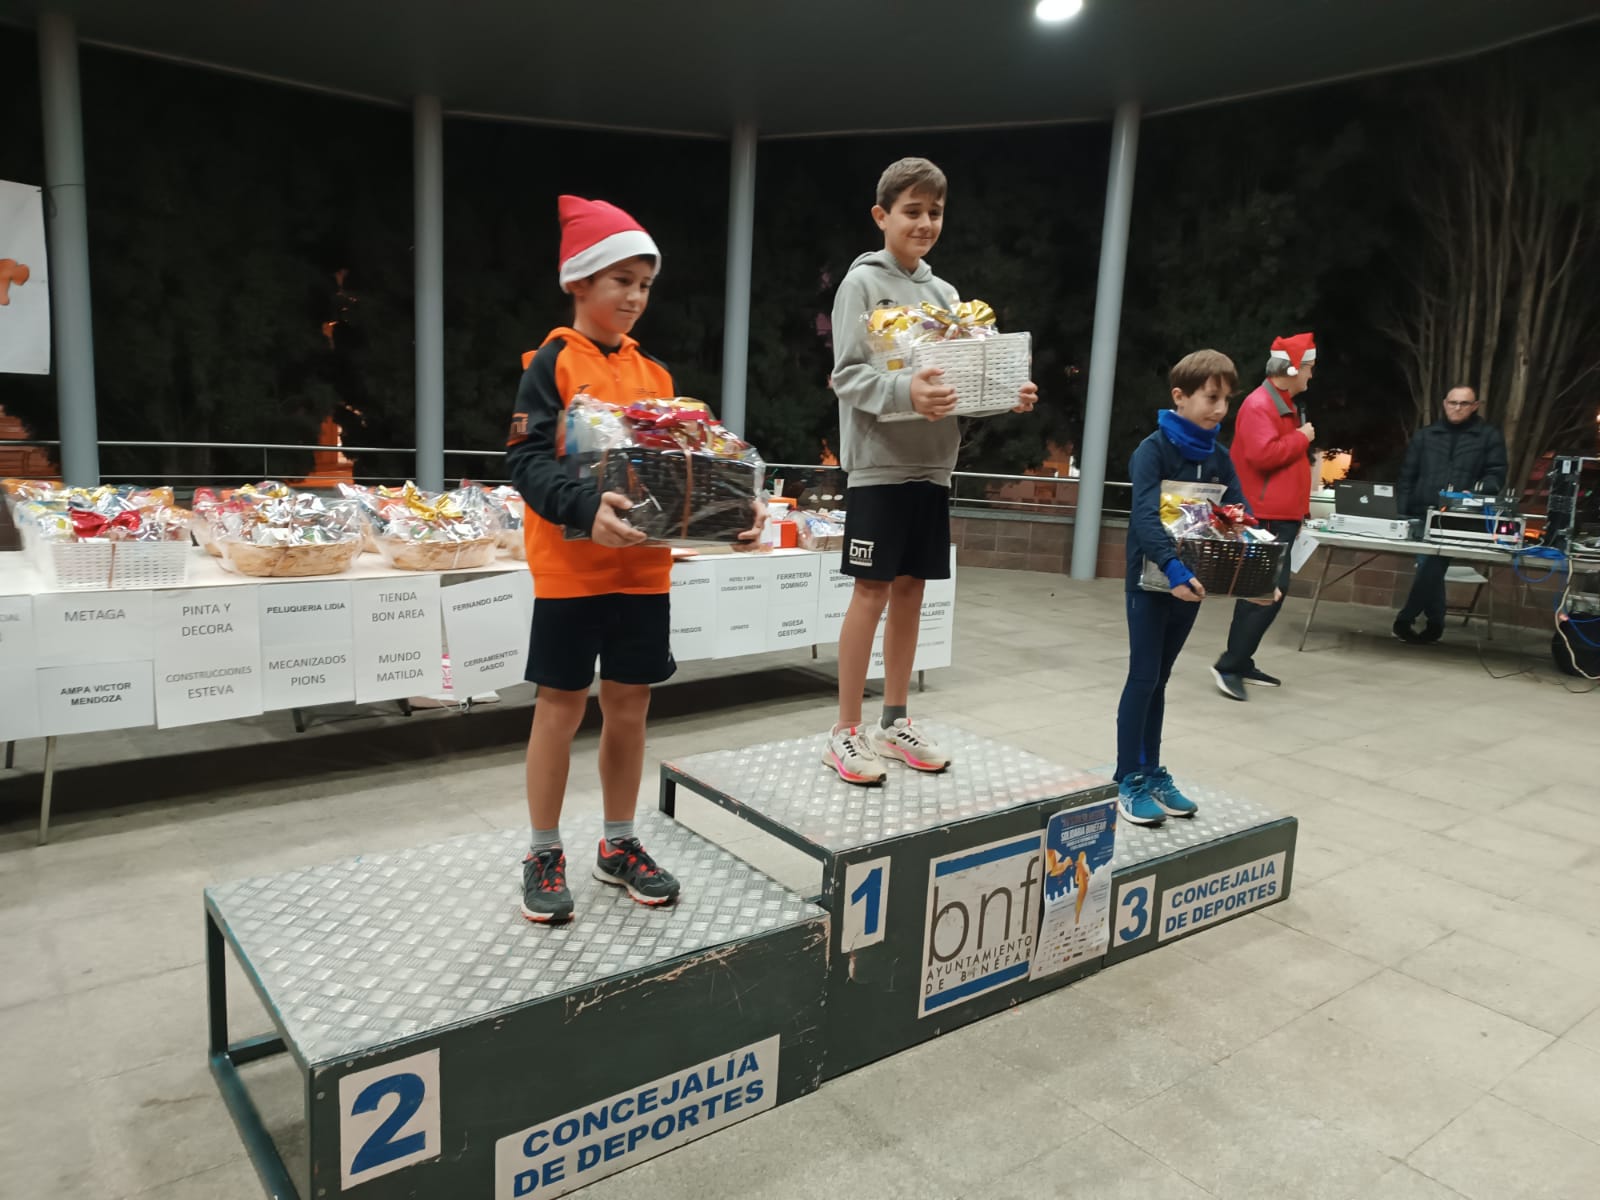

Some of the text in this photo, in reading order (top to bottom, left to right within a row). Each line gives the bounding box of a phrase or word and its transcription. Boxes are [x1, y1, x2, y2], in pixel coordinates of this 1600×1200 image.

[849, 542, 875, 559] bnf
[780, 581, 809, 590] DOMINGO
[379, 591, 417, 603] TIENDA
[182, 603, 231, 616] PINTA Y
[266, 602, 346, 614] PELUQUERIA LIDIA
[452, 598, 492, 612] FERNANDO
[64, 609, 126, 622] METAGA
[371, 608, 425, 622] BON AREA
[181, 623, 234, 637] DECORA
[268, 654, 347, 670] MECANIZADOS
[378, 651, 422, 664] MUNDO
[165, 666, 252, 683] CONSTRUCCIONES
[290, 674, 326, 686] PIONS
[376, 668, 424, 682] MATILDA
[60, 682, 132, 695] AMPA VICTOR
[187, 684, 234, 699] ESTEVA
[70, 694, 122, 706] MENDOZA
[1171, 860, 1275, 908] CONCEJALIA
[851, 867, 883, 935] 1
[1165, 881, 1277, 933] DE DEPORTES
[928, 856, 1040, 966] bnf
[1119, 886, 1148, 941] 3
[926, 935, 1032, 981] AYUNTAMIENTO
[925, 982, 946, 995] DE
[350, 1072, 426, 1176] 2
[513, 1079, 764, 1198] DE DEPORTES
